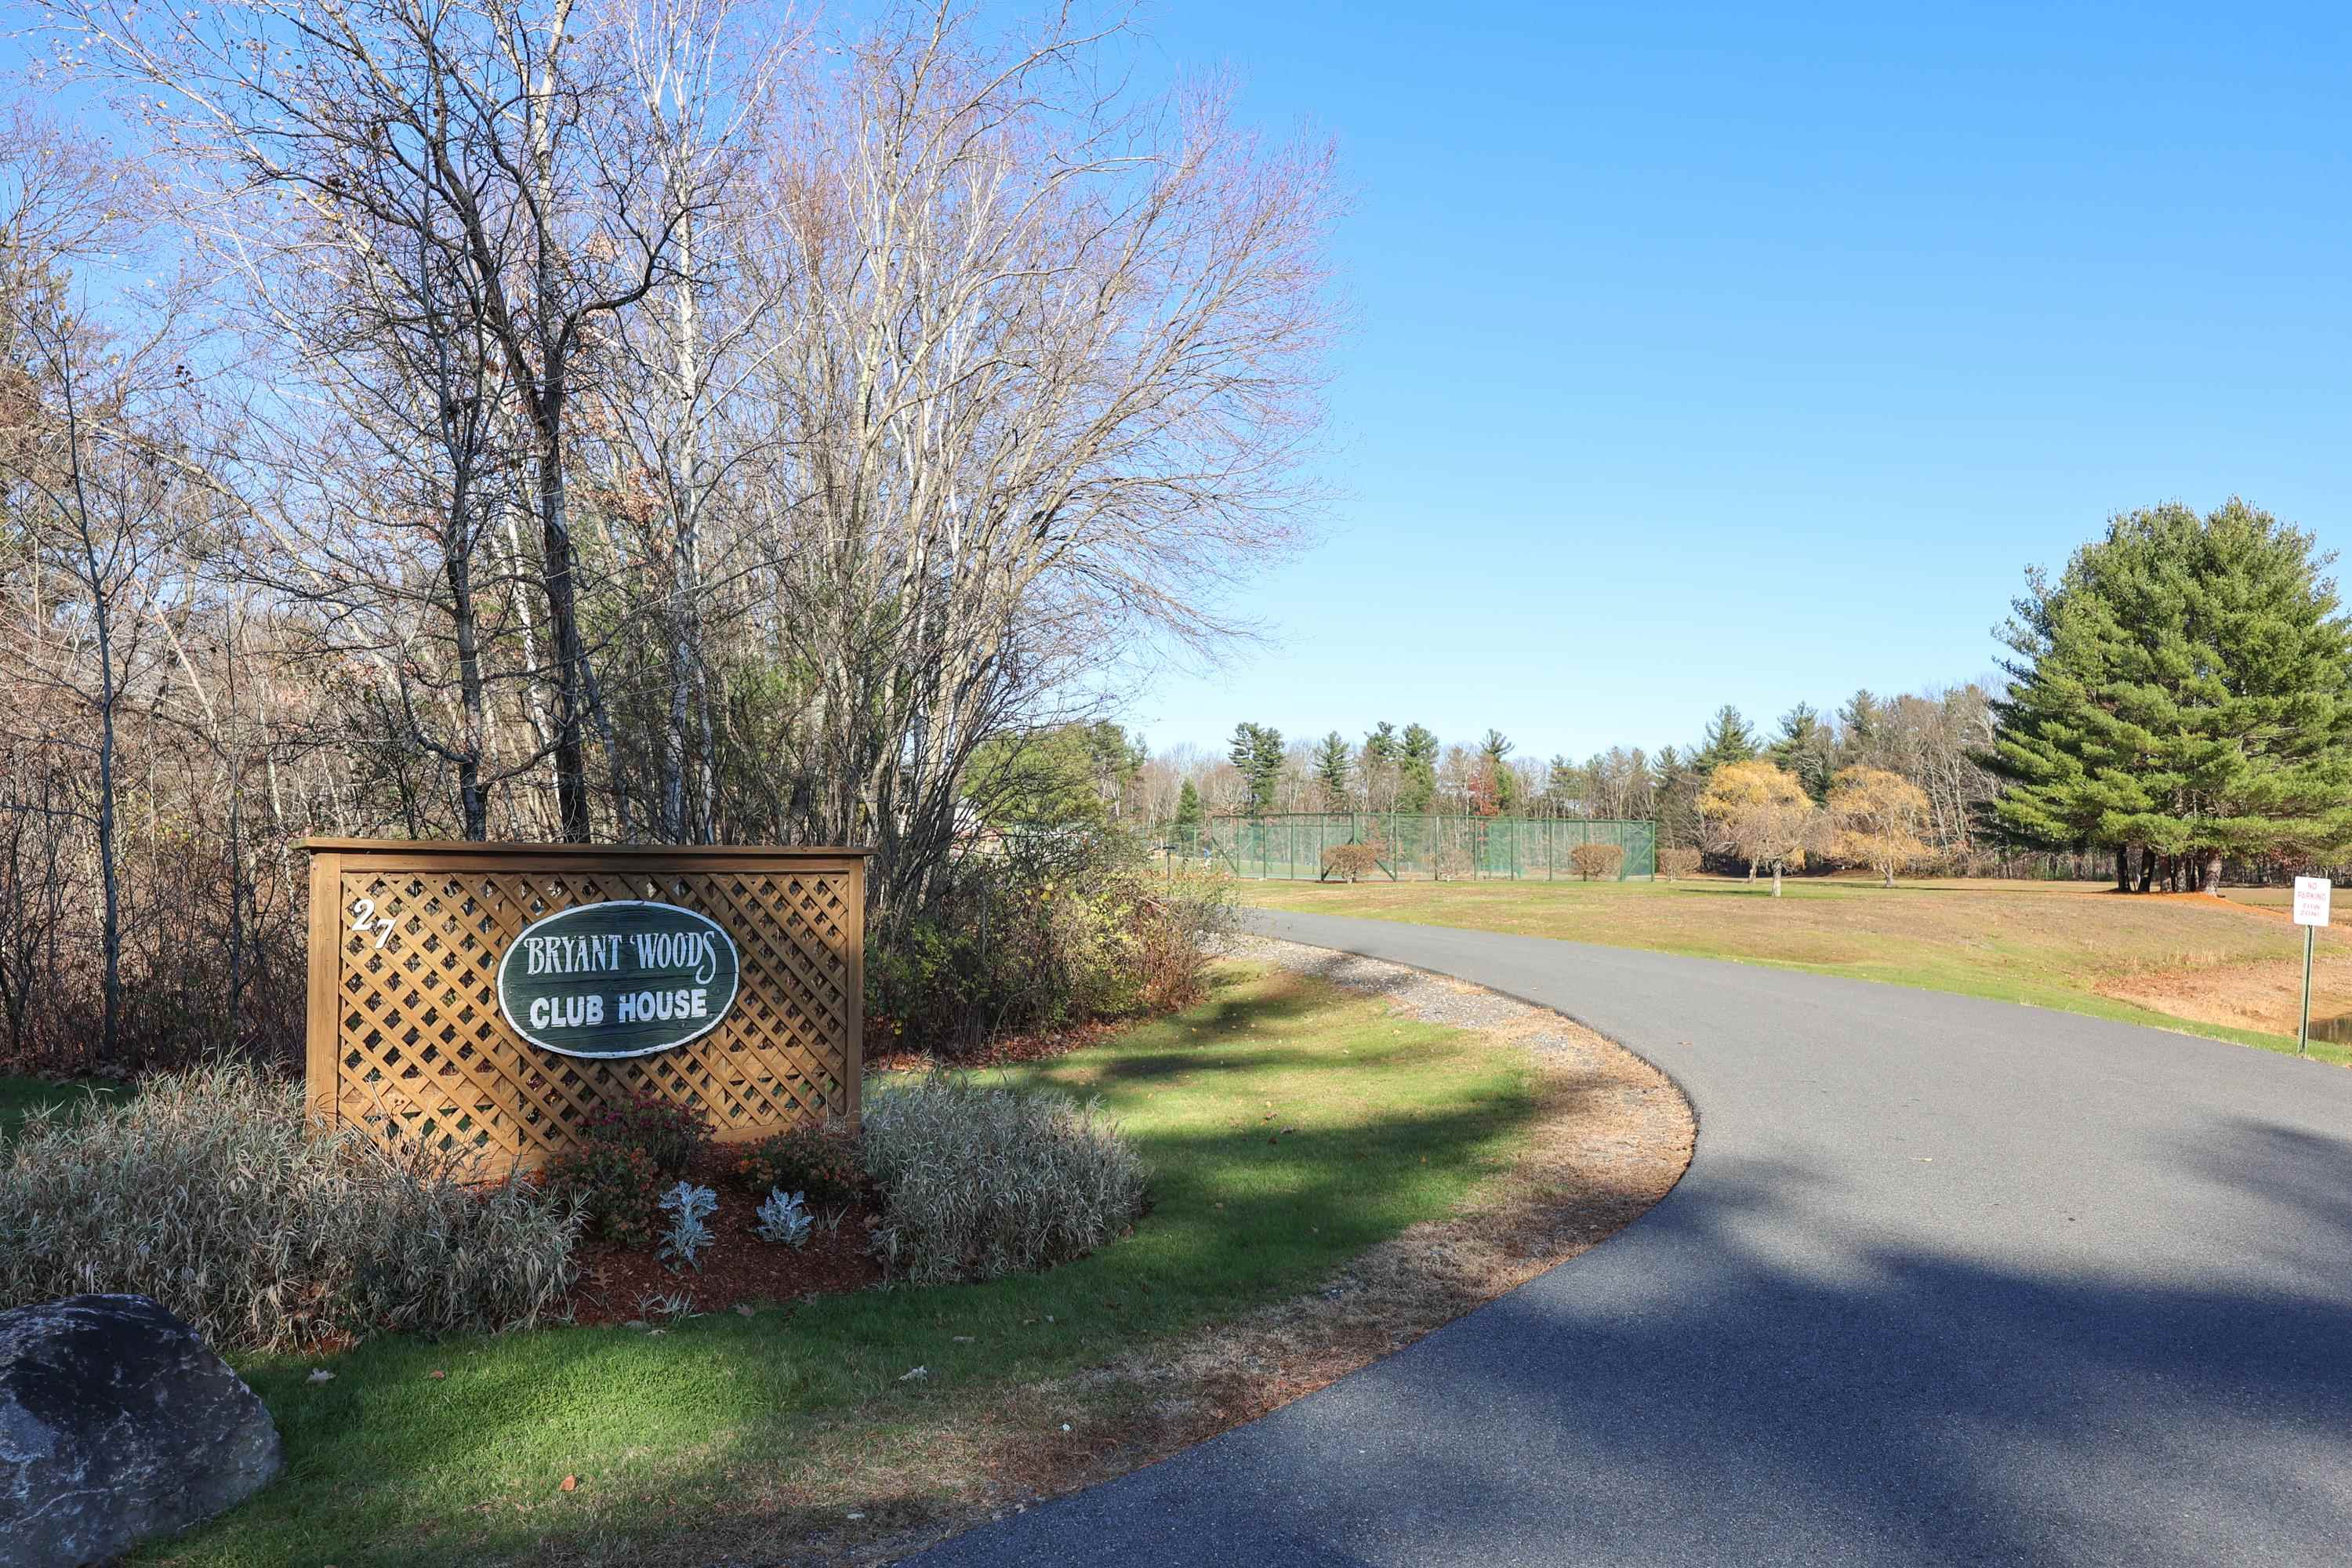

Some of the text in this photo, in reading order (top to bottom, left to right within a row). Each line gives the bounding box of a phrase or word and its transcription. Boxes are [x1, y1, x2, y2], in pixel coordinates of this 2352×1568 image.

[2297, 891, 2326, 901] PARKING
[2307, 882, 2318, 891] NO
[351, 898, 397, 949] 27
[524, 931, 716, 985] BRYANT WOODS
[529, 989, 707, 1029] CLUB HOUSE
